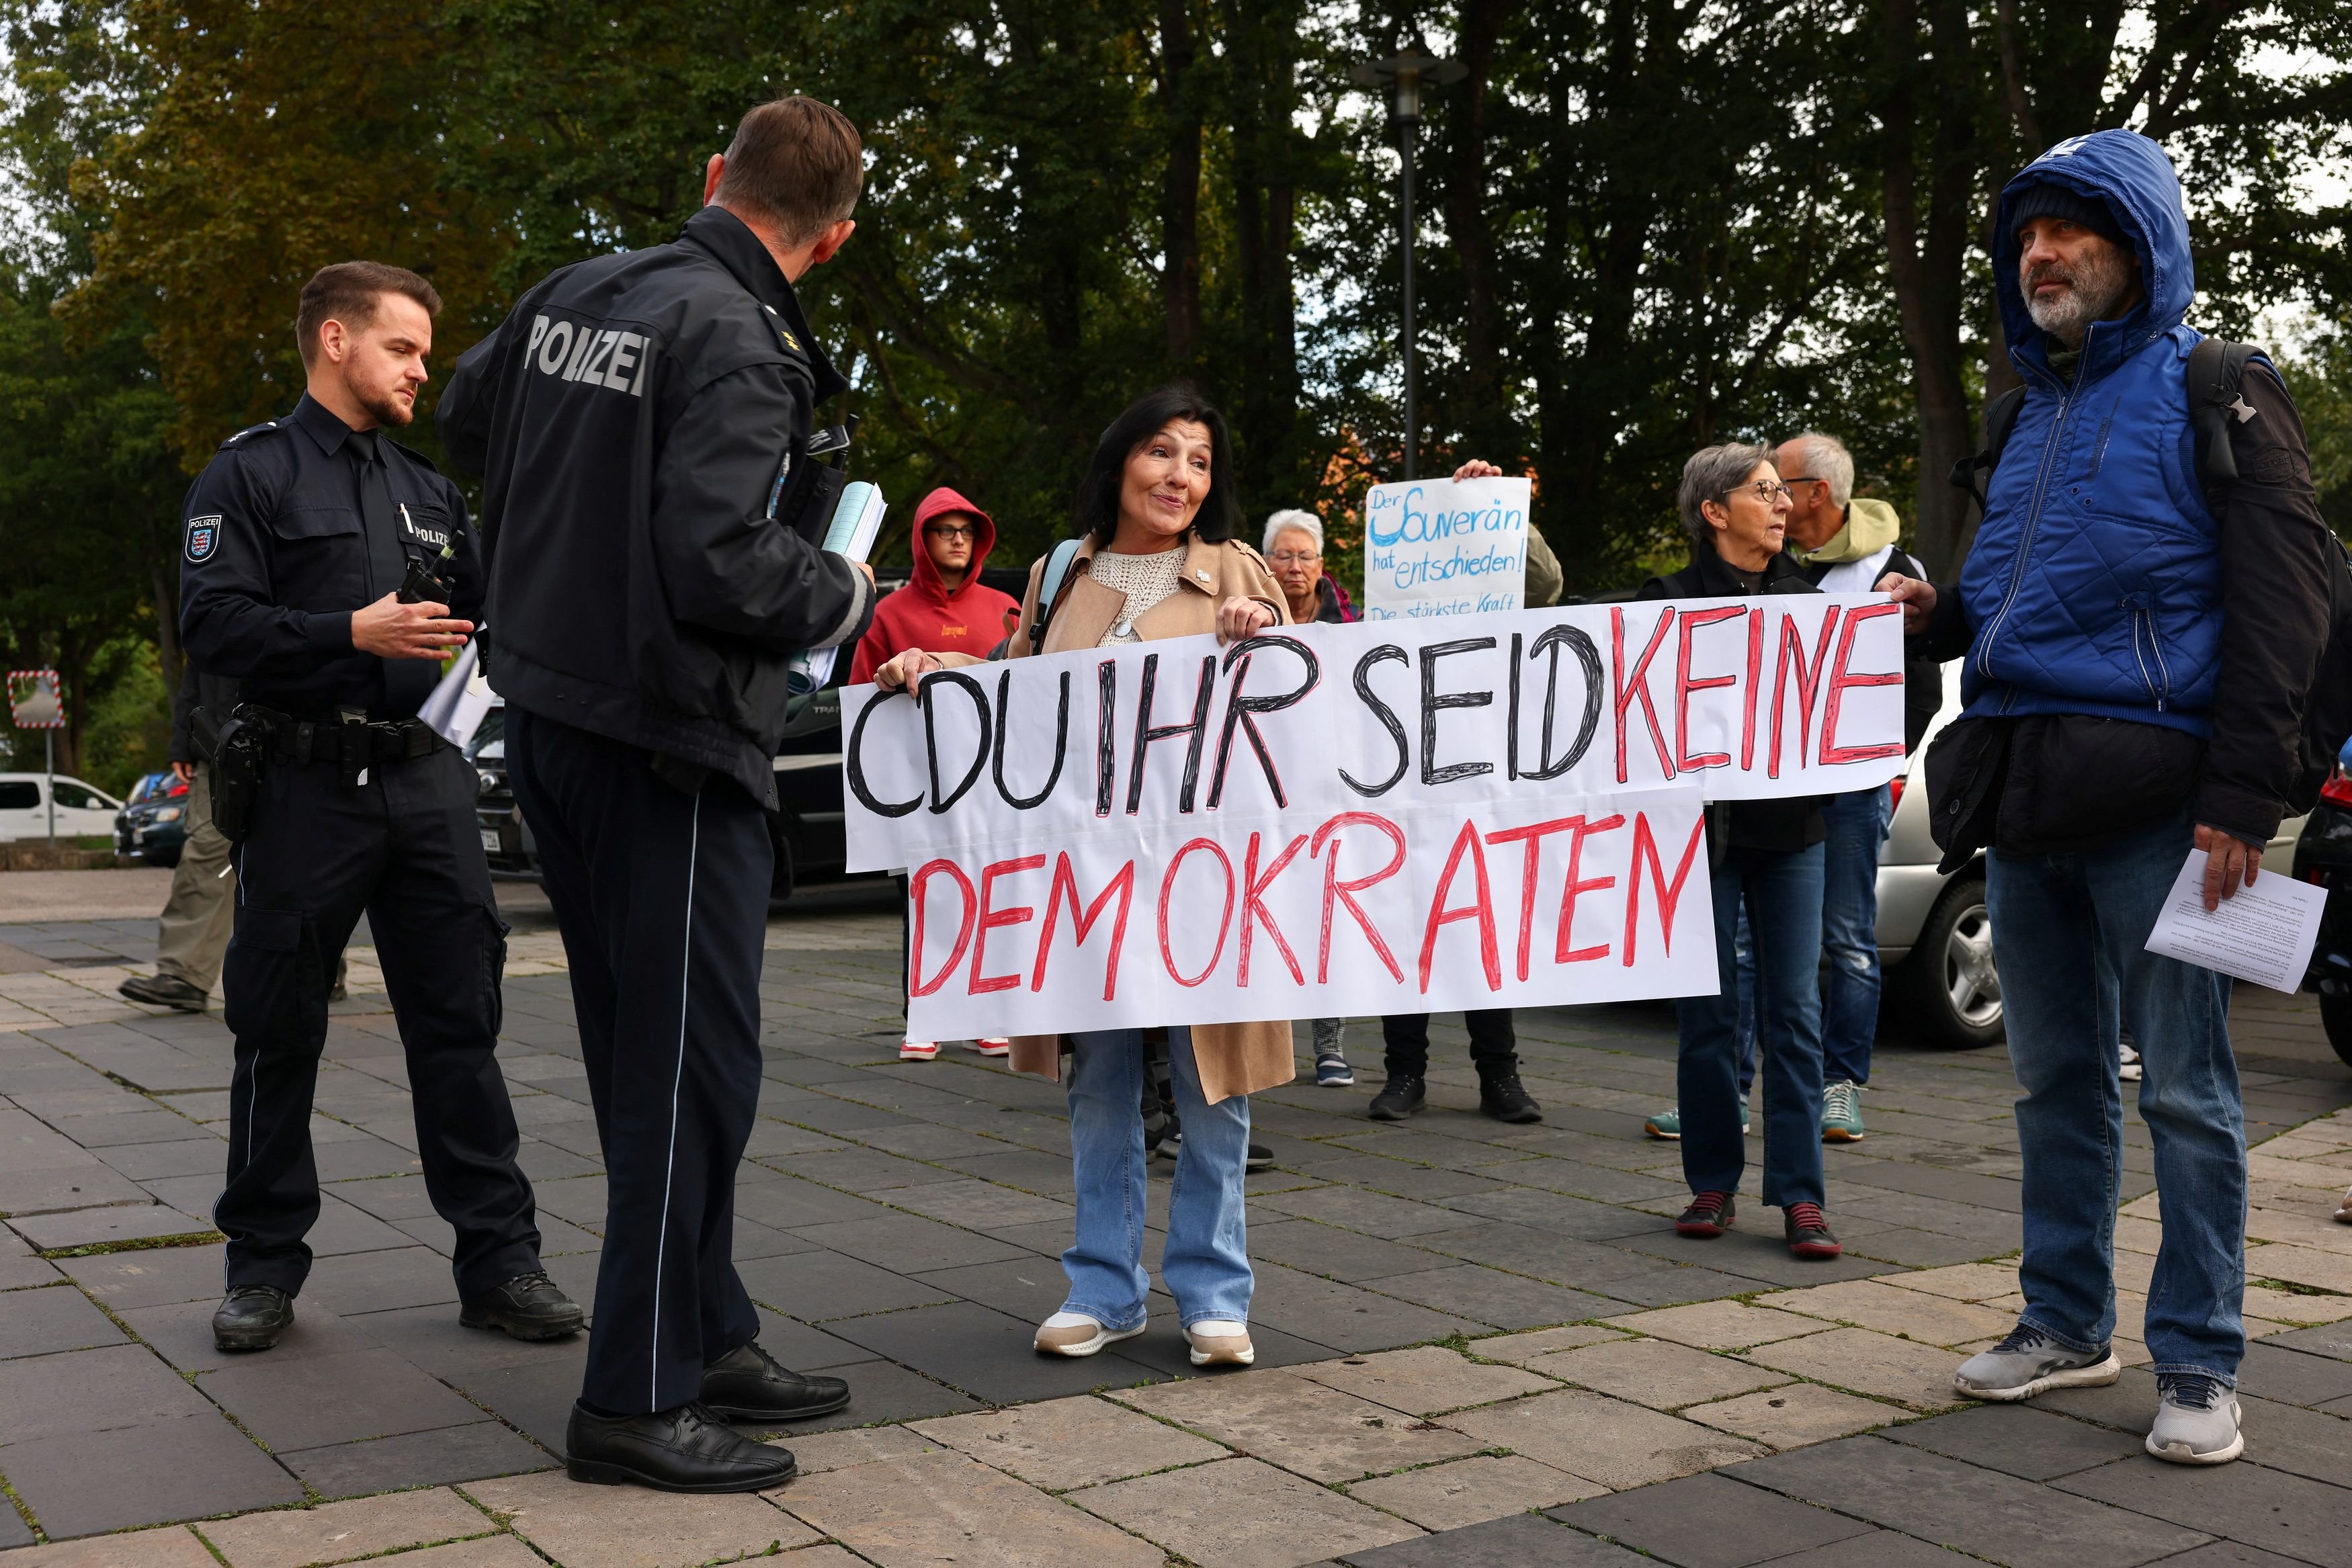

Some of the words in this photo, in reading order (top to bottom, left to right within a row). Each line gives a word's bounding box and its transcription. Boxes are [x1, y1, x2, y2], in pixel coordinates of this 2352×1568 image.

[523, 314, 651, 398] POLIZEI
[190, 518, 219, 529] POLIZEI
[1369, 487, 1521, 547] Souverän
[1371, 490, 1401, 509] Der
[415, 525, 450, 546] POLIZE
[1373, 548, 1396, 572] hat
[1394, 537, 1525, 589] entschieden!
[1371, 607, 1396, 621] Die
[1476, 592, 1515, 613] Kraft
[847, 668, 1070, 818] CDU
[1095, 634, 1322, 818] IHR
[1338, 624, 1605, 798] SEID
[1610, 601, 1906, 783] KEINE
[909, 811, 1706, 1002] DEMOKRATEN
